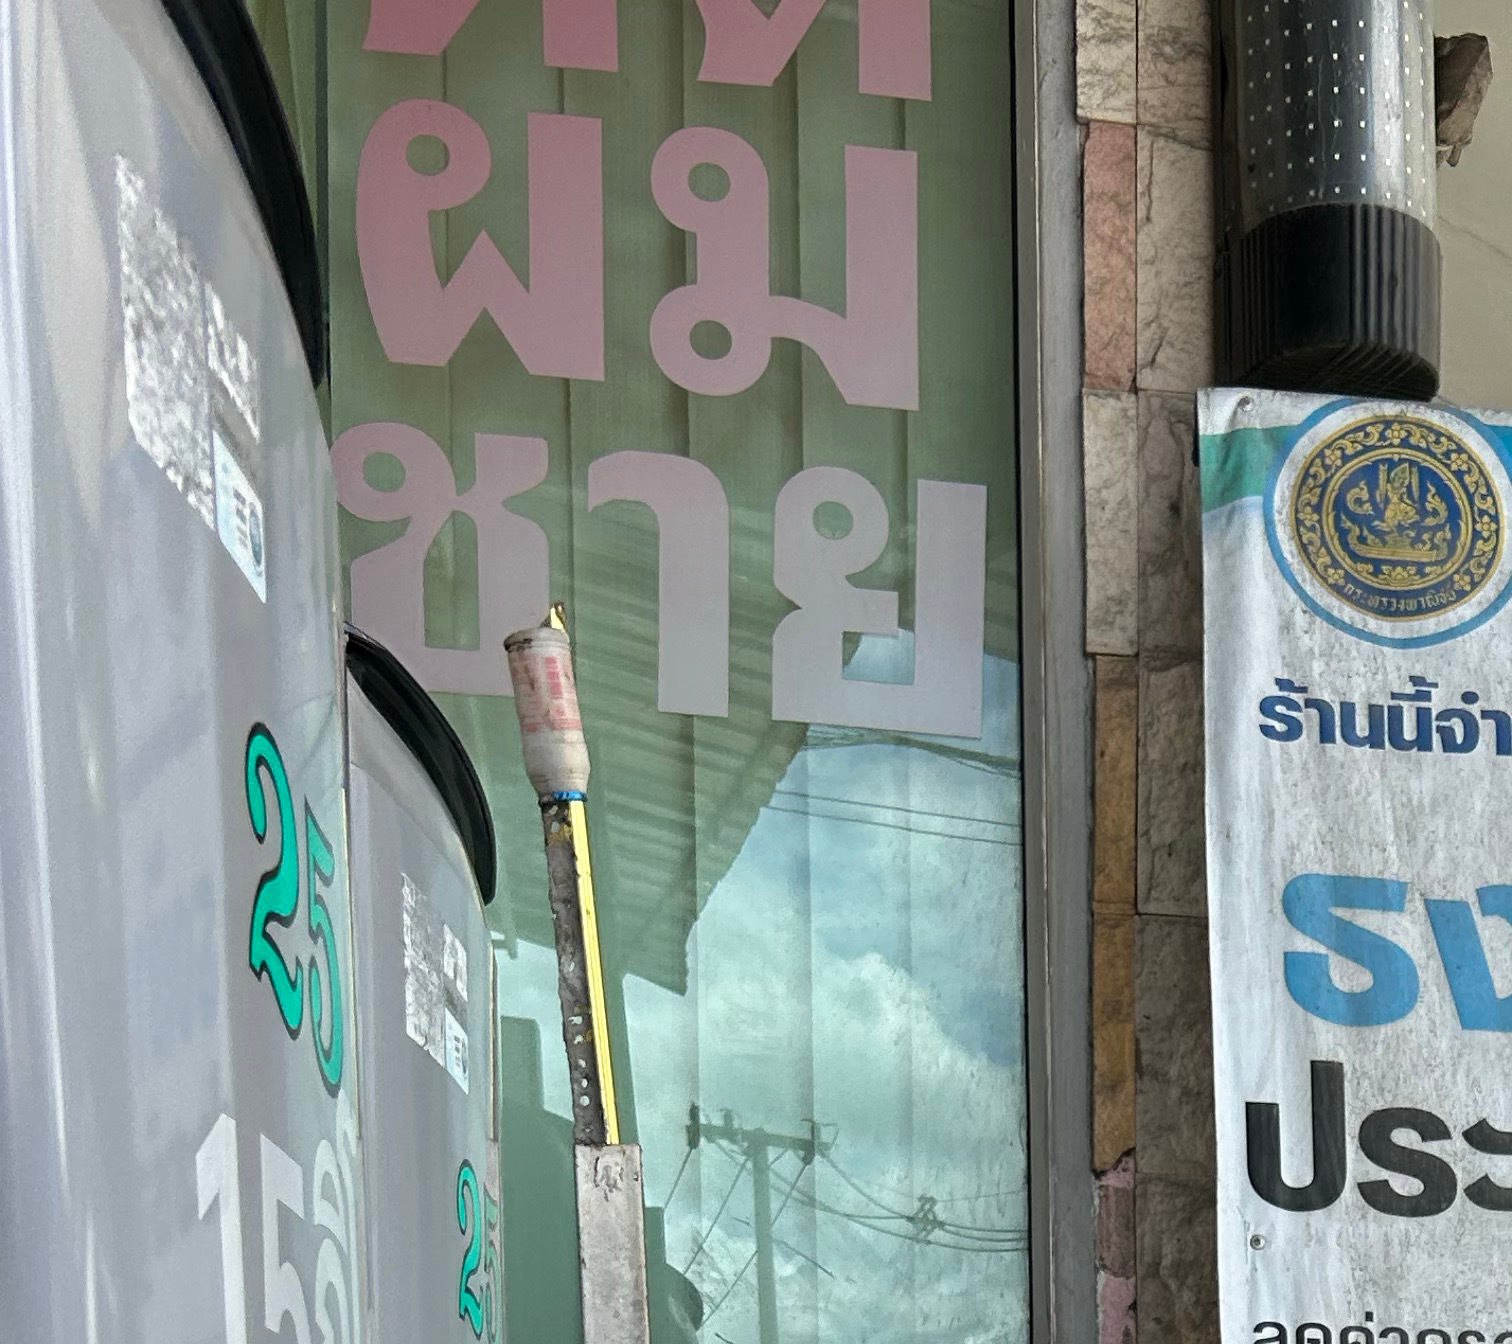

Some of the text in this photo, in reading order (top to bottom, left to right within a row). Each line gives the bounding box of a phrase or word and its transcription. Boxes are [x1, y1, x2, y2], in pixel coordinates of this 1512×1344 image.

[356, 98, 919, 411] ผม
[331, 421, 987, 739] ชาย
[244, 721, 345, 1096] 25
